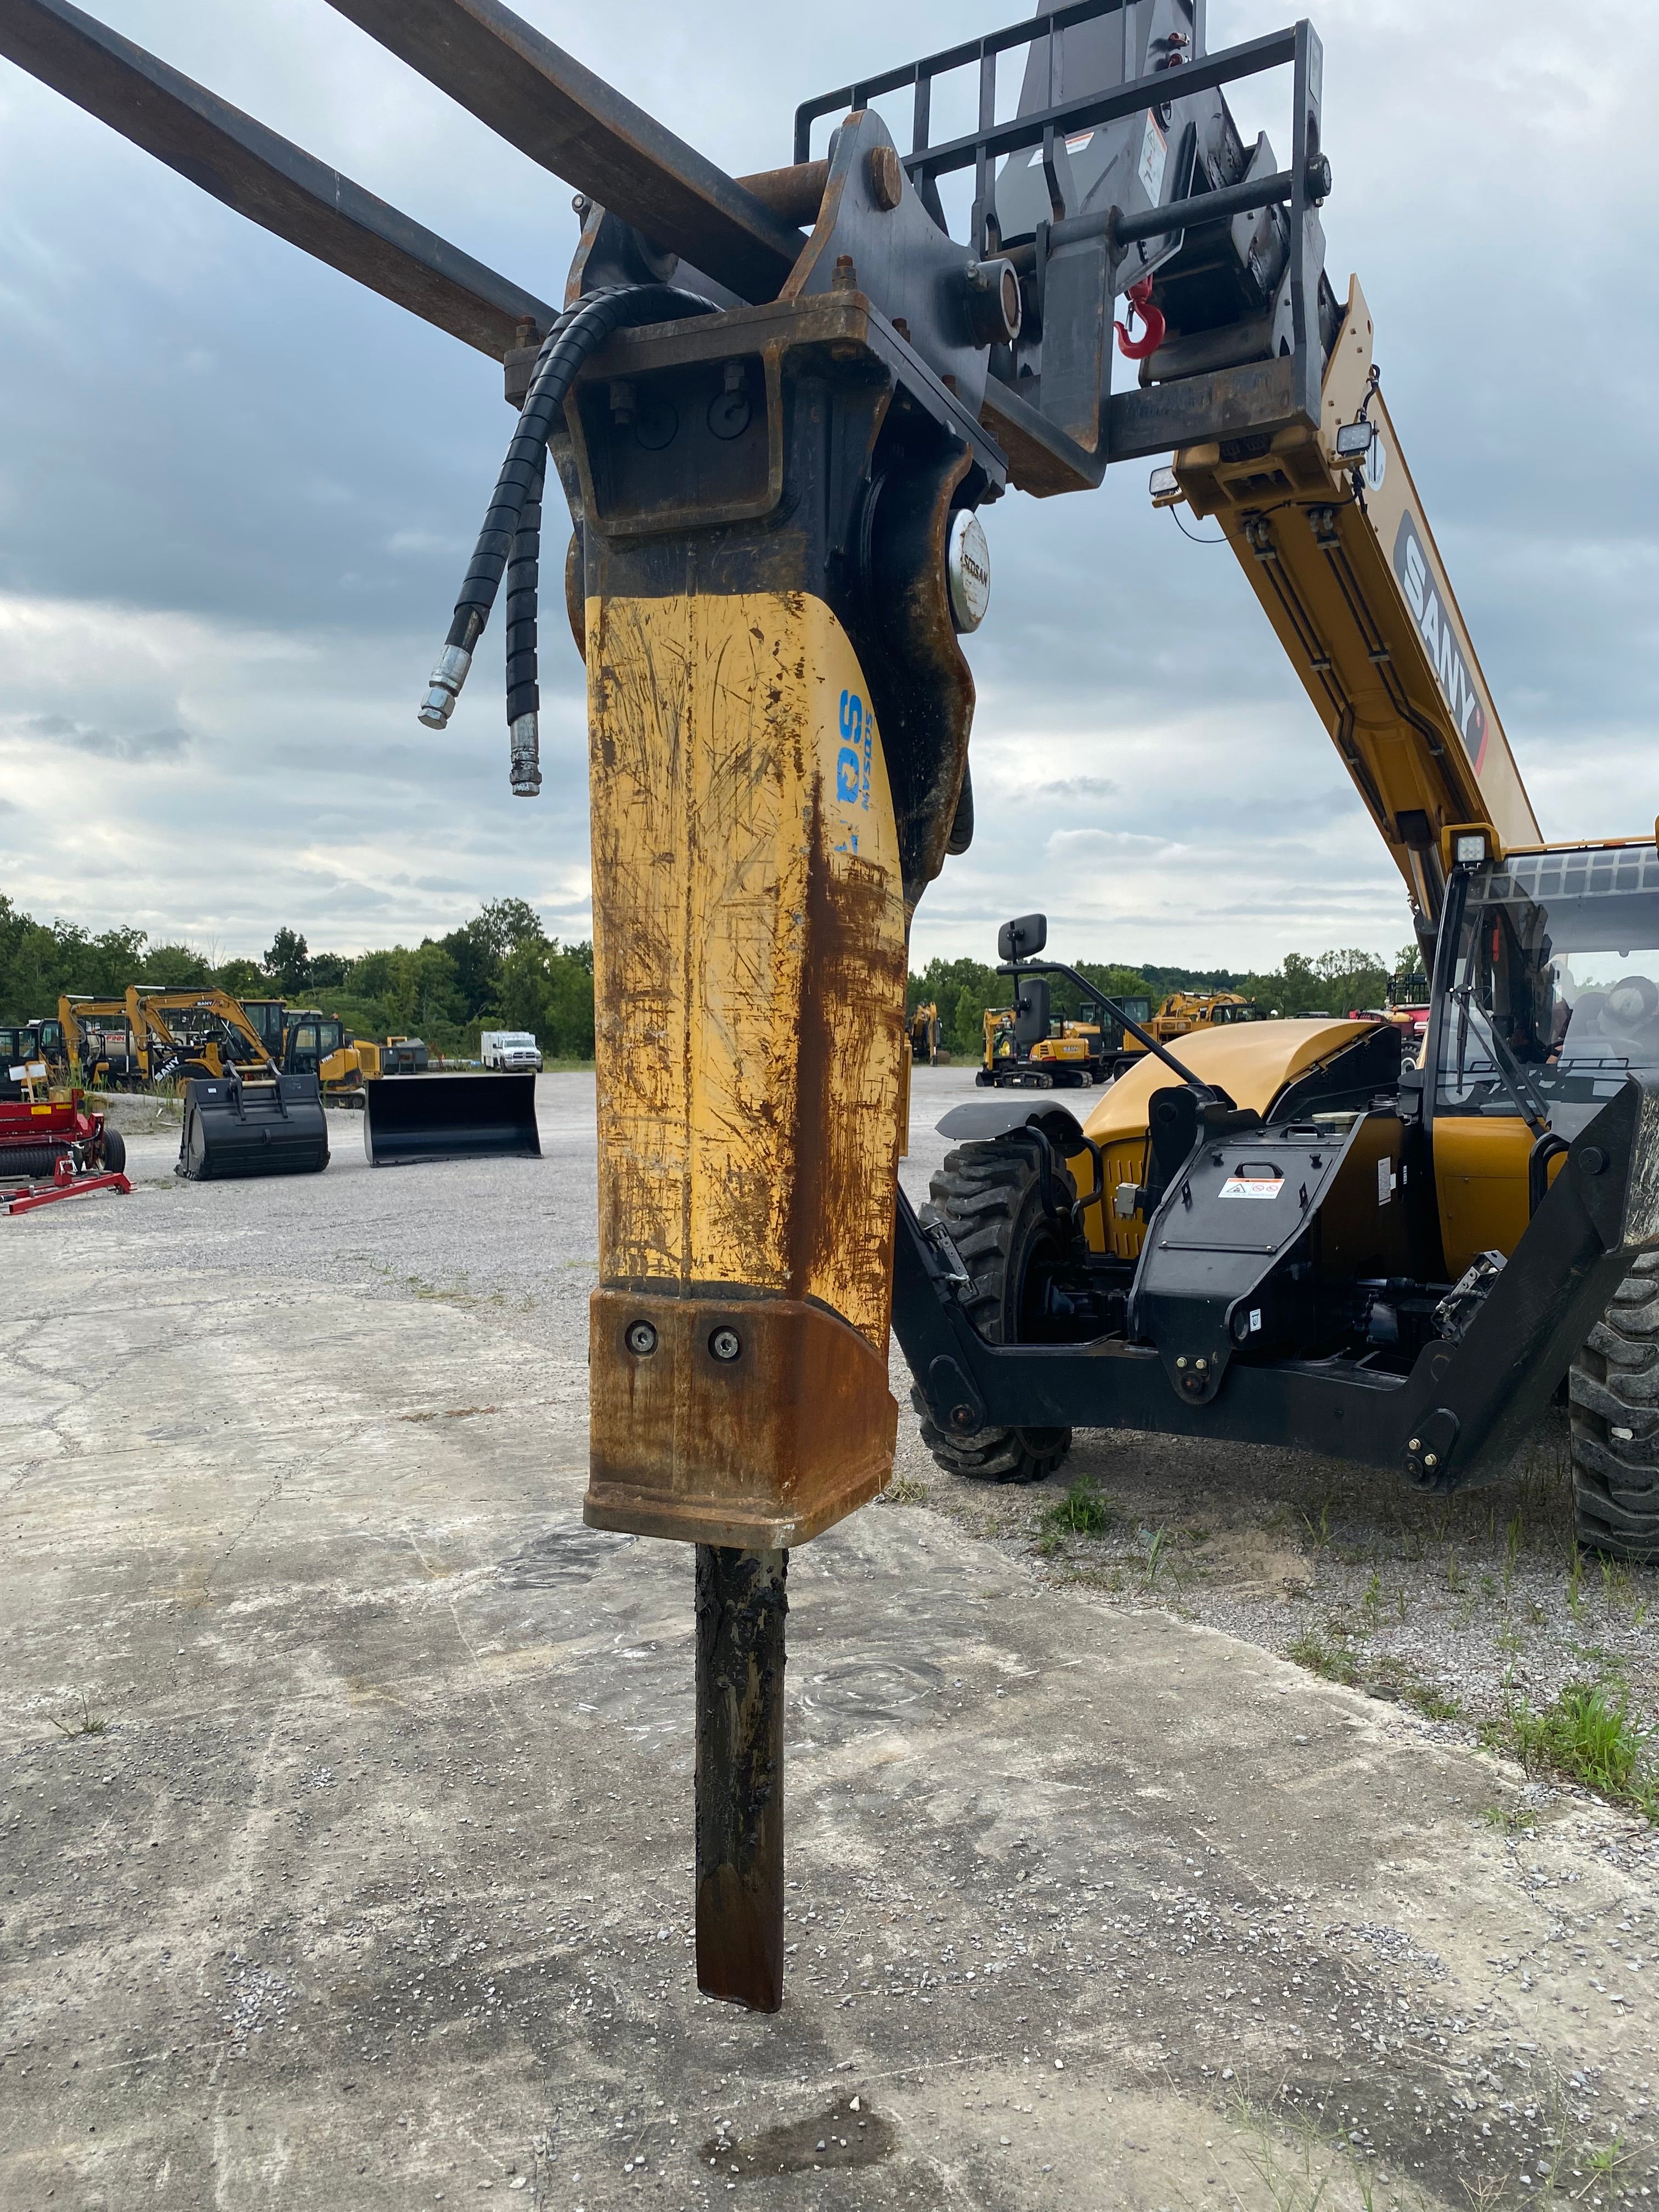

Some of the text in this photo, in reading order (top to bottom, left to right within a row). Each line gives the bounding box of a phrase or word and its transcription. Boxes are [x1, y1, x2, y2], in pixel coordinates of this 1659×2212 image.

[1403, 535, 1476, 740] SANY
[862, 709, 872, 812] SOOSAN
[154, 1056, 179, 1081] SANY
